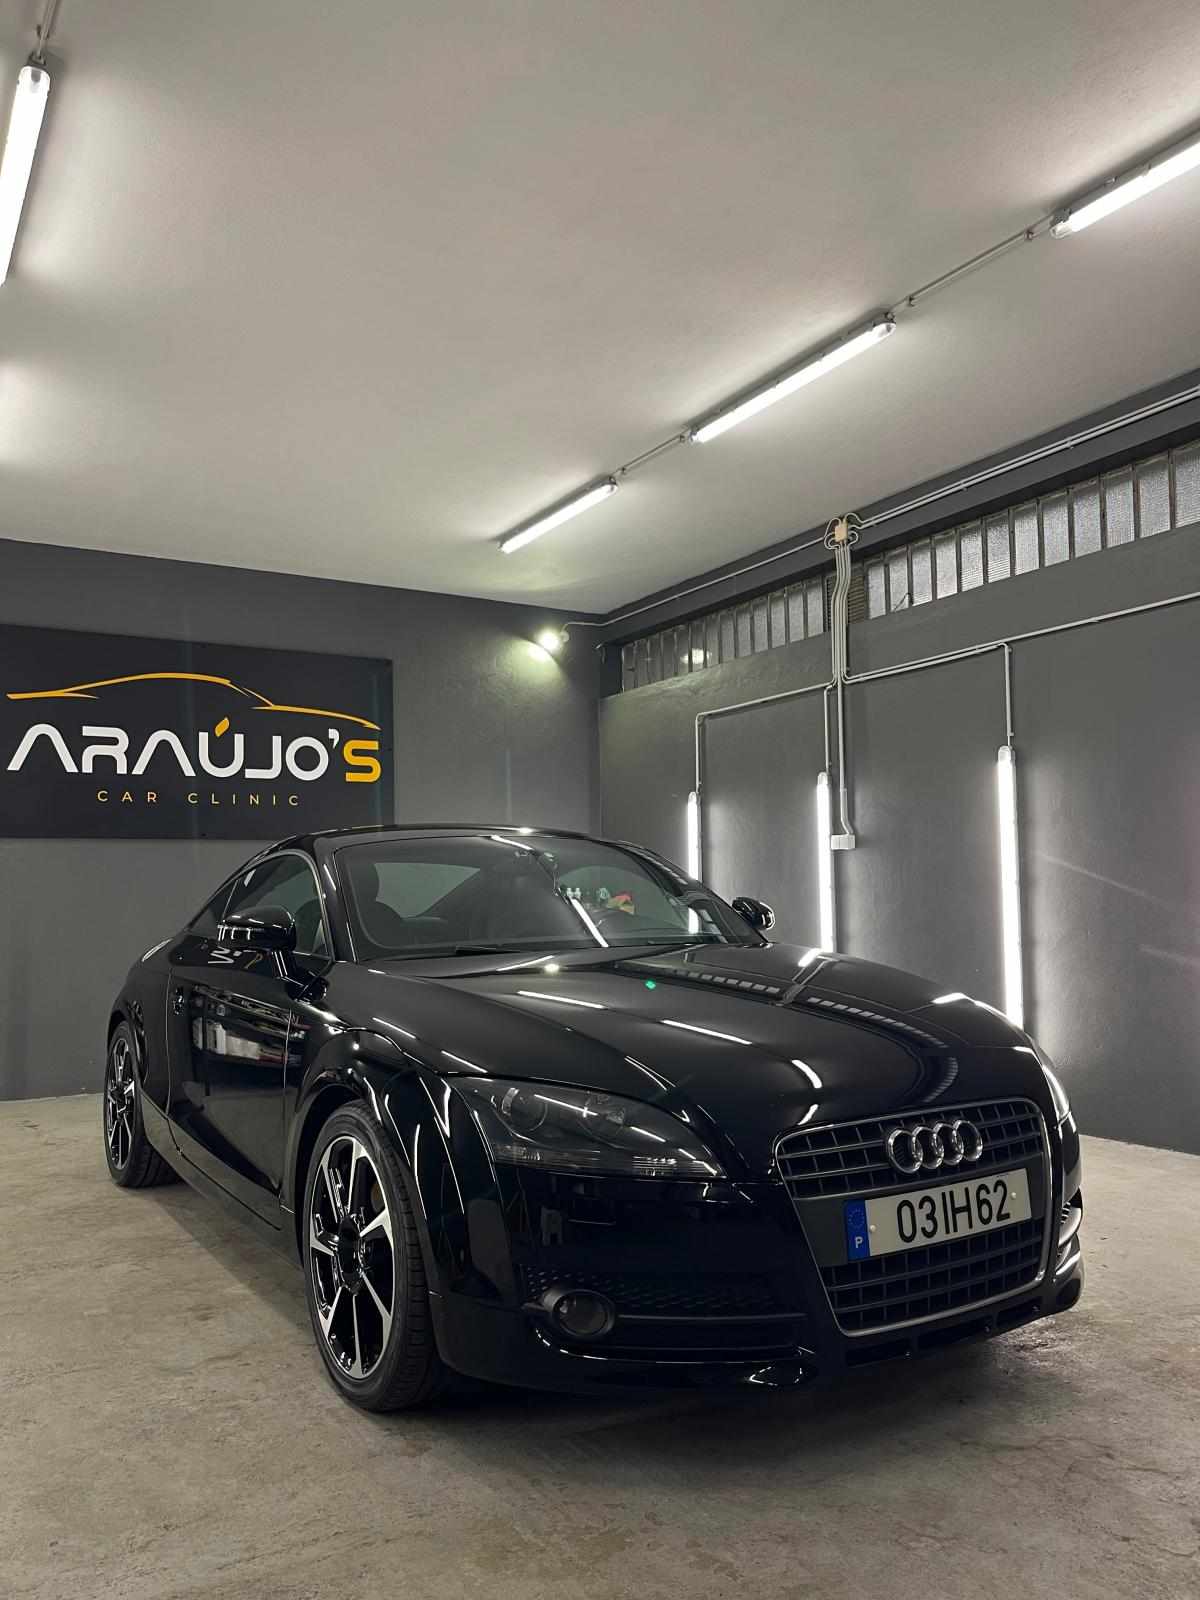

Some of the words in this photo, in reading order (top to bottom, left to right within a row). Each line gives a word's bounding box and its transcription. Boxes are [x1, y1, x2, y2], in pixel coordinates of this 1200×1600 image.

[97, 790, 158, 803] CAR
[187, 791, 300, 806] CLINIC
[896, 1180, 1010, 1243] 03IH62
[855, 1236, 863, 1249] P
